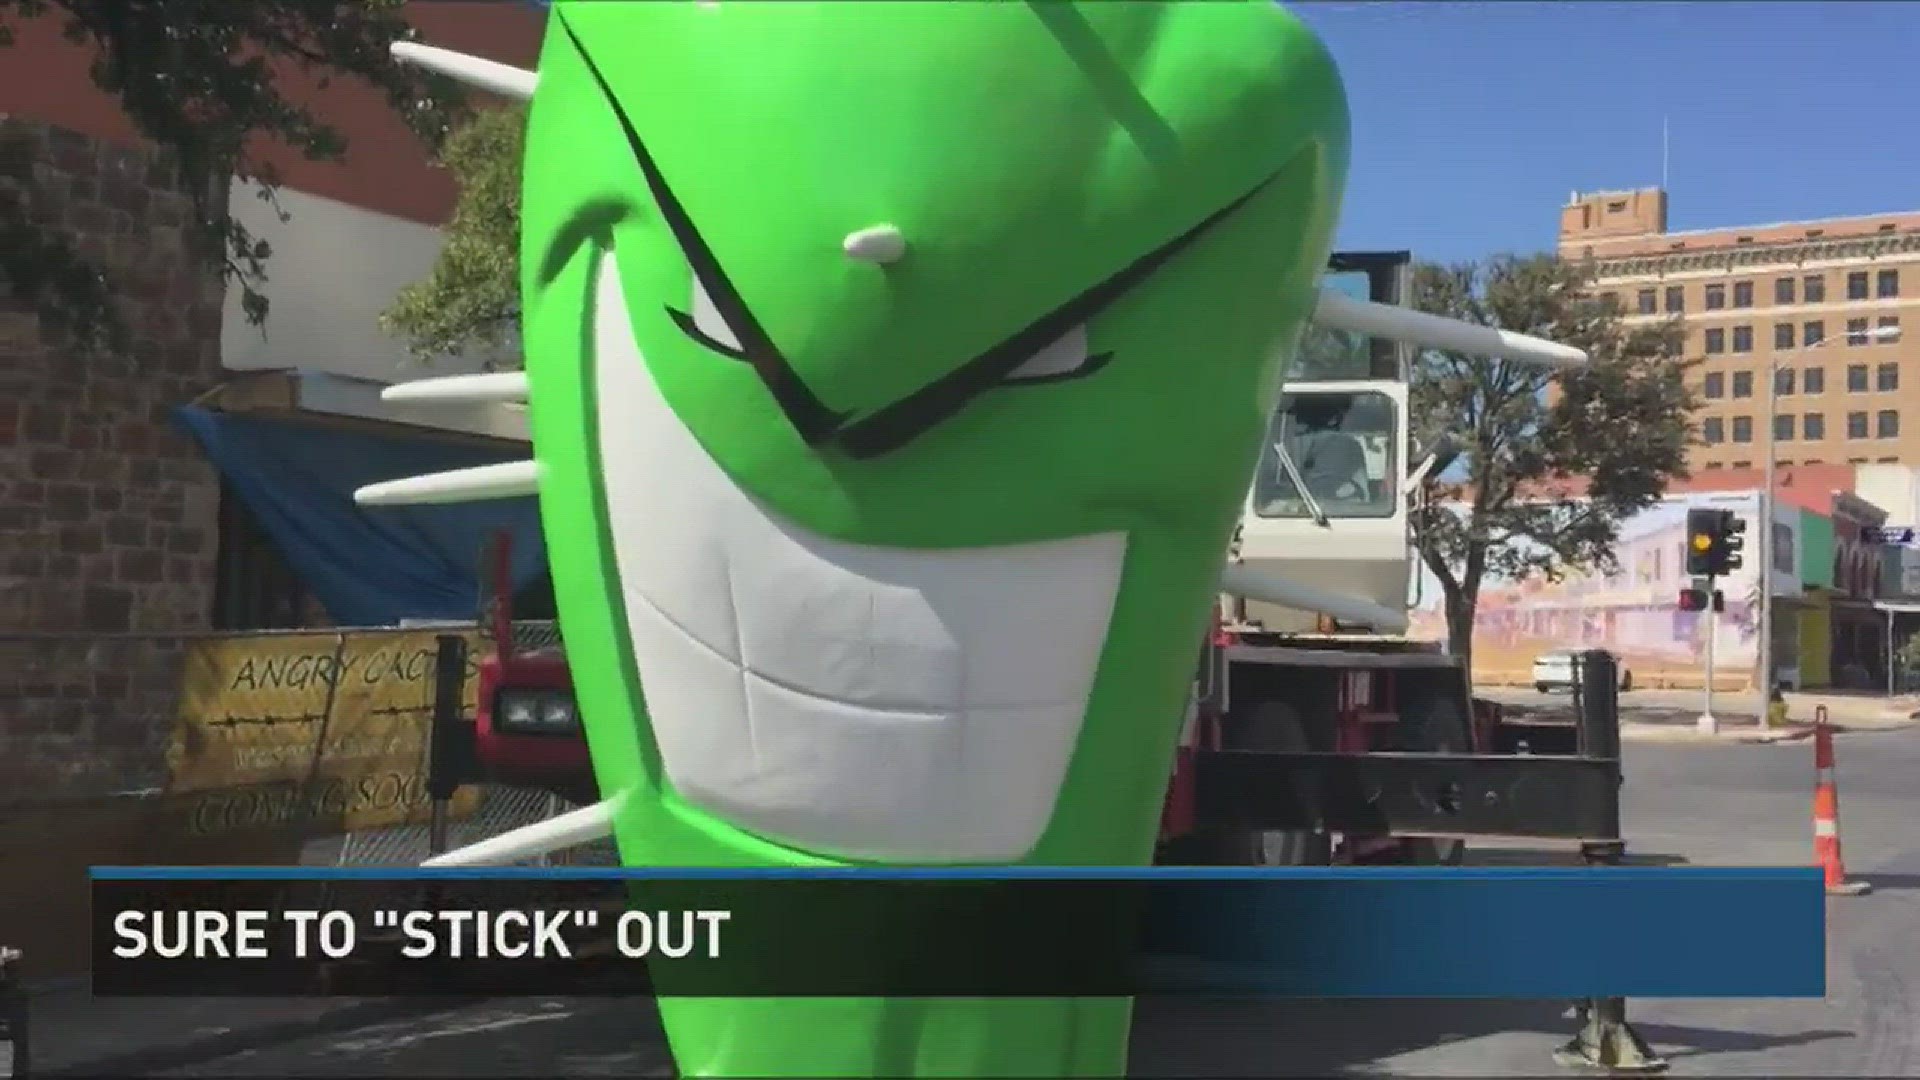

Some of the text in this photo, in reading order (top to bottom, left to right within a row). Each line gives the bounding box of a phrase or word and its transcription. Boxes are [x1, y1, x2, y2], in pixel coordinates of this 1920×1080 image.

[231, 648, 480, 690] ANGRY CACS
[190, 769, 433, 833] COMIG SOO
